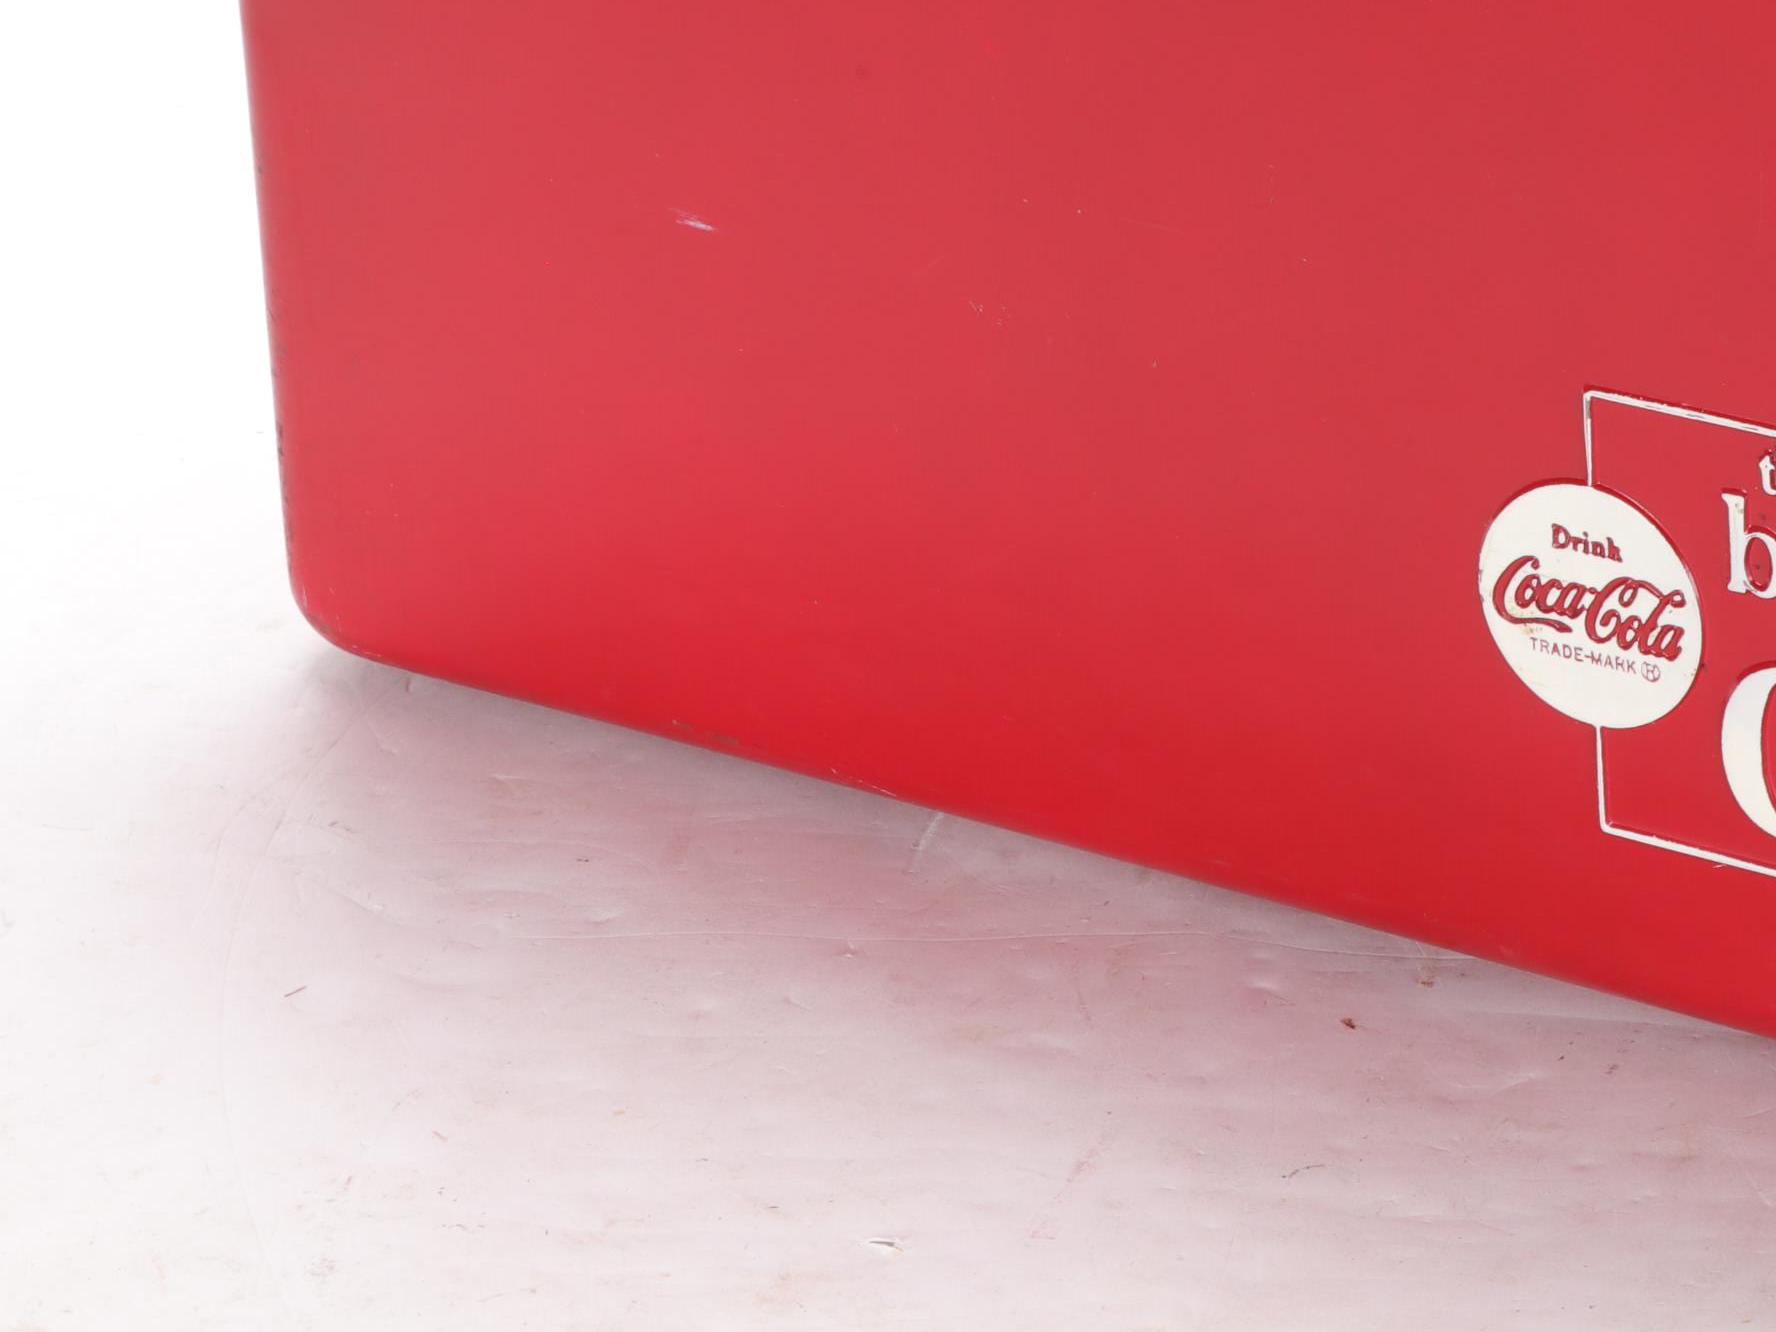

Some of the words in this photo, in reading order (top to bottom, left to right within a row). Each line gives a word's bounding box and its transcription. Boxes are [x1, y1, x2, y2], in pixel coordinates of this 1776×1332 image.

[1551, 523, 1623, 563] Drink
[1492, 555, 1686, 661] Coca-Cola
[1529, 636, 1637, 675] TRADE-MARK
